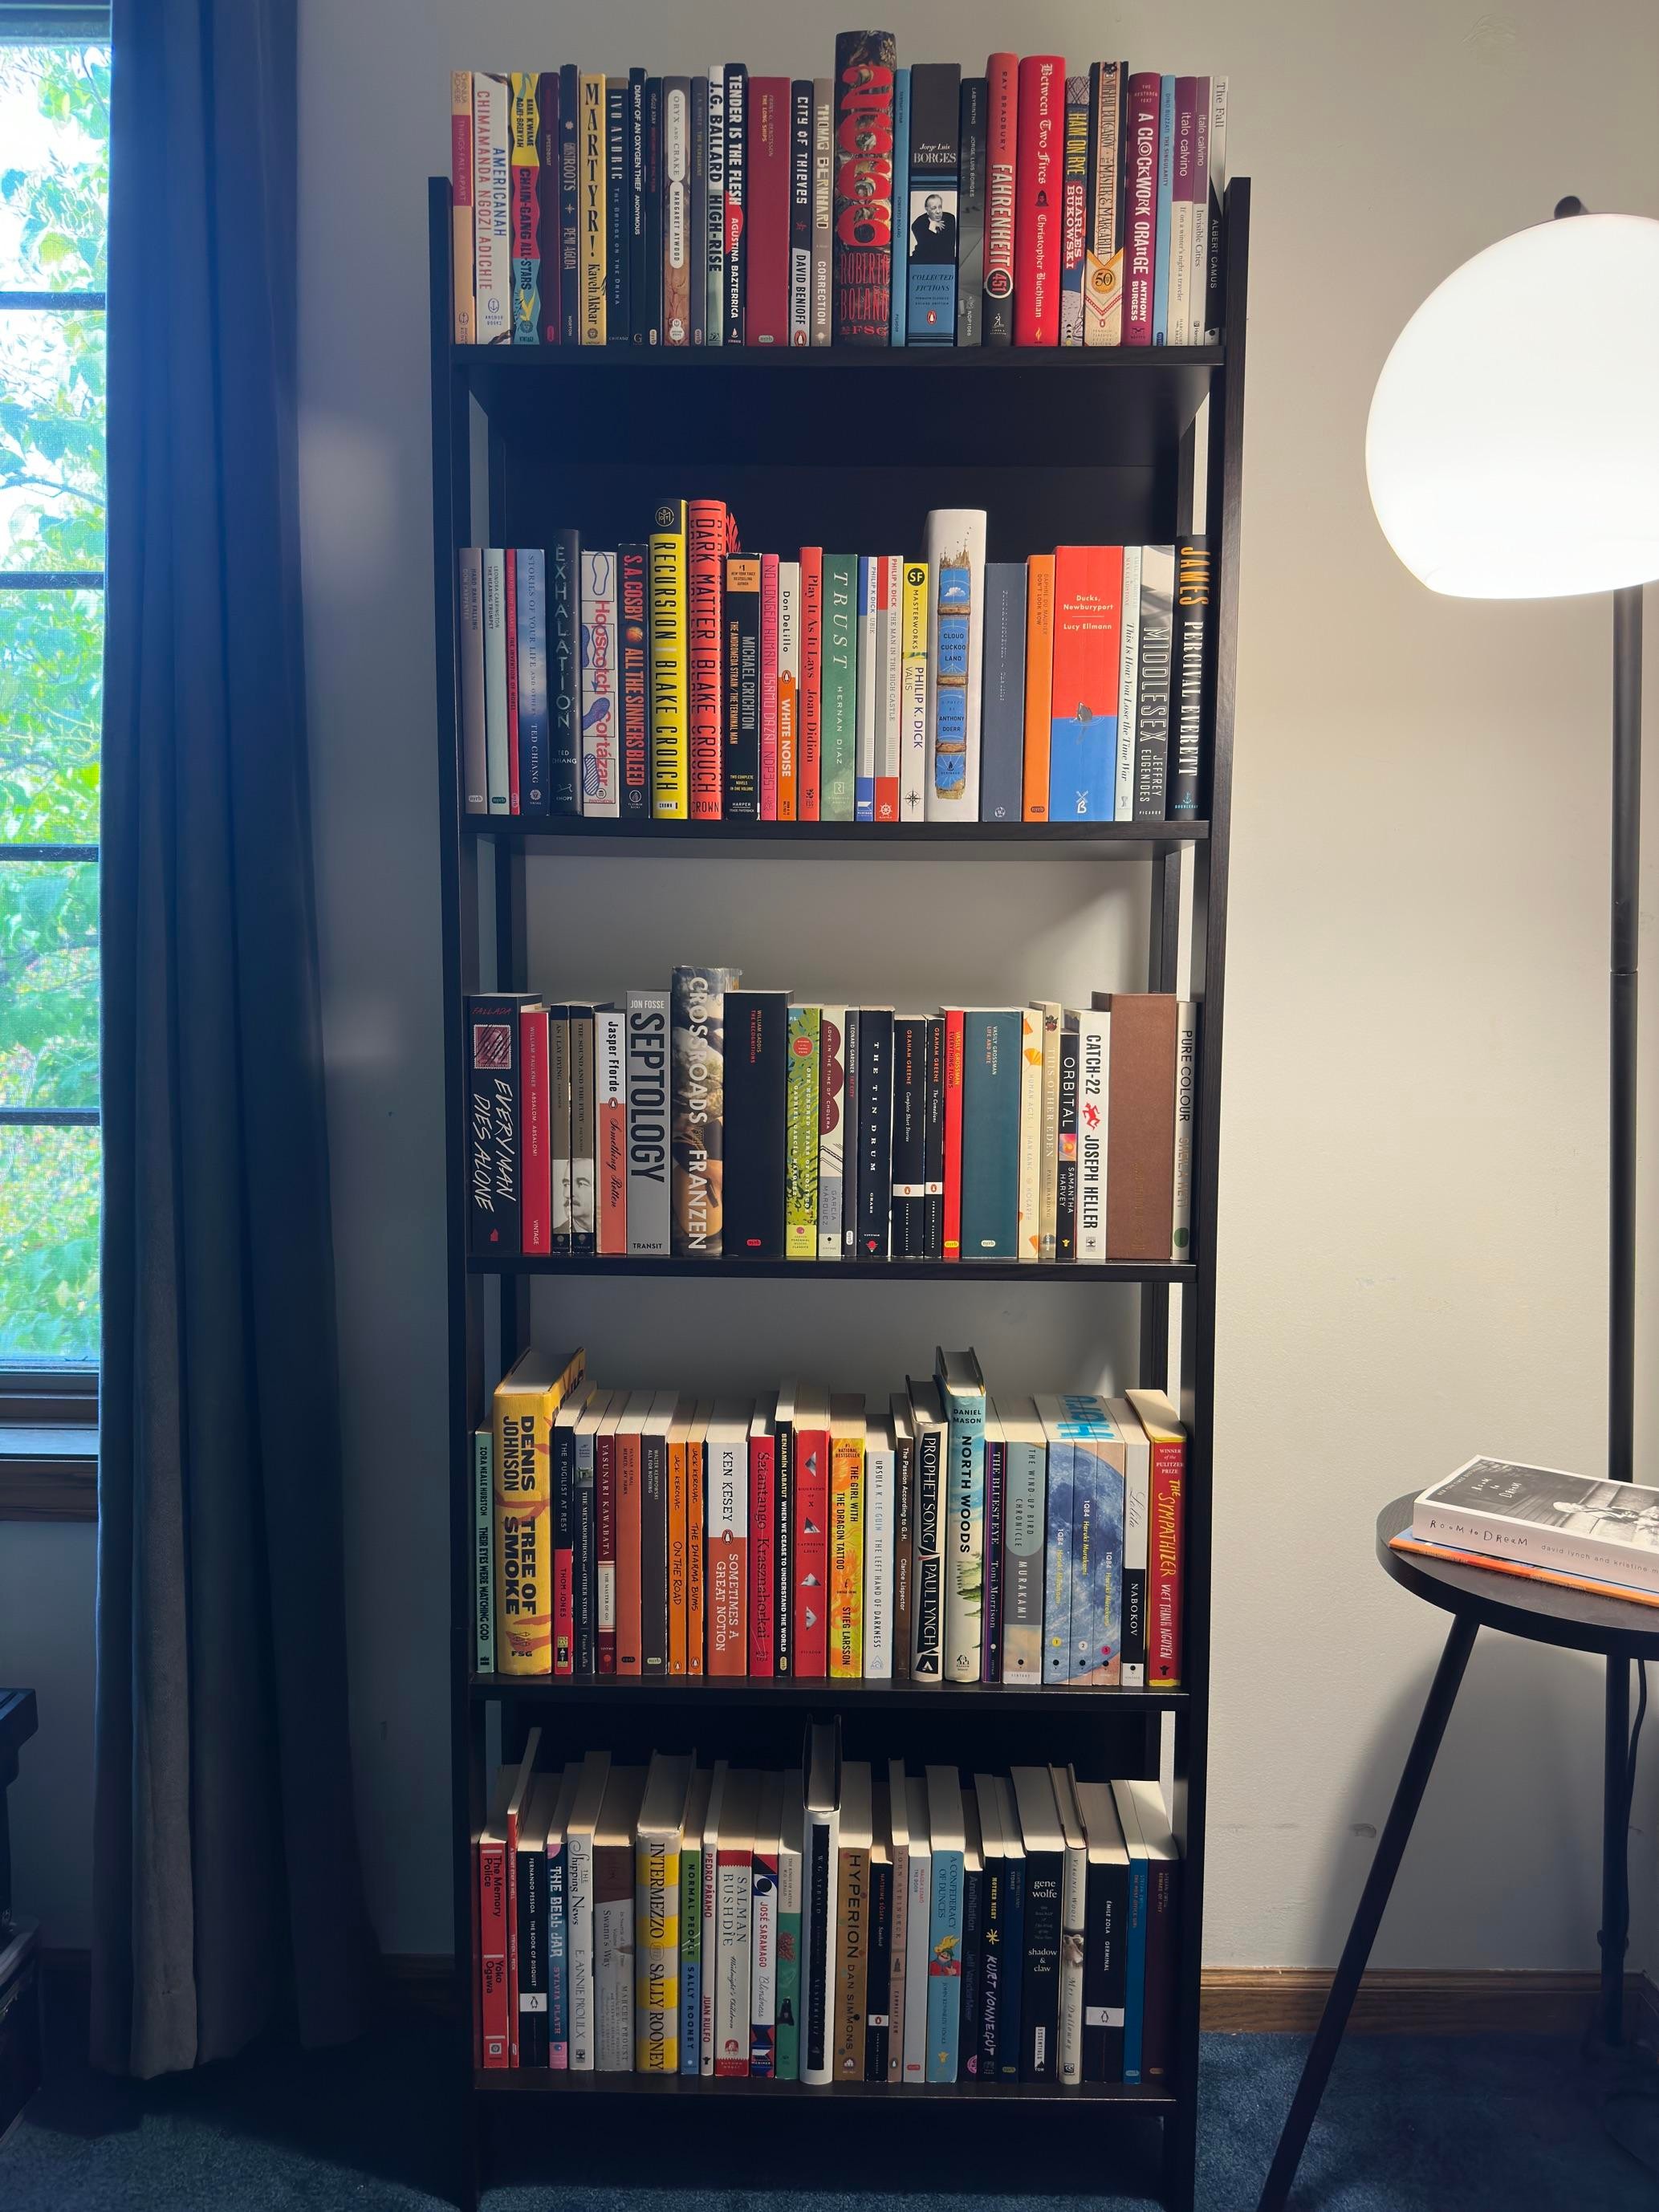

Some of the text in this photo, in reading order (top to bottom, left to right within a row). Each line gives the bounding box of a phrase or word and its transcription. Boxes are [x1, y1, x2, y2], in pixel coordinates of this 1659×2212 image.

[1215, 82, 1226, 128] The Fall
[709, 82, 722, 272] J.G. BALLARD HIGH-RISE
[1179, 112, 1192, 177] italo calvino
[478, 91, 493, 290] CHIMAMANDA NGOZI ADICHIE
[493, 148, 506, 236] AMERICANAH
[585, 83, 601, 324] MARTYR! Kaveh Akbar
[729, 75, 742, 319] TENDER IS THE FLESH AGUSTINA BAZTERRICA
[990, 164, 1013, 292] FAHRENHEIT 451
[1066, 185, 1074, 269] BUKOWSKI
[1074, 185, 1083, 257] CHARLES
[519, 168, 533, 290] CHAIN-GANG ALL-STARS
[1210, 219, 1219, 289] ALBERT CAMUS
[795, 254, 807, 324] DAVID BENIOFF
[1131, 280, 1139, 321] BURGESS
[1139, 280, 1148, 322] ANTHONY
[695, 518, 717, 793] DARK MATTER BLAKE CROUCH
[833, 571, 848, 669] TRUST
[624, 555, 644, 786] S.A. COSBY ALL THE SINNERS BLEED
[654, 542, 678, 791] RECURSION BLAKE CROUCH
[781, 591, 791, 777] Don DeLillo WHITE NOISE
[905, 666, 913, 691] VALIS
[1140, 627, 1169, 742] MIDDLESEX
[1178, 547, 1210, 776] JAMES PERCIVAL EVERETT
[913, 666, 925, 748] PHILIP K. DICK
[1139, 750, 1152, 802] EUGENIDES
[1152, 754, 1163, 796] JEFFREY
[630, 1000, 665, 1008] JON FOSSE
[606, 1021, 620, 1092] Jasper Fforde
[1062, 1057, 1075, 1127] ORBITAL
[630, 1012, 665, 1182] SEPTOLOGY
[688, 977, 708, 1249] CROSSROADS FRANZEN
[1083, 1035, 1101, 1229] CATCH-22 JOSEPH HELLER
[473, 1094, 494, 1213] DIES ALONE
[1059, 1173, 1067, 1207] HARVEY
[1067, 1167, 1075, 1213] SAMANTHA
[503, 1416, 519, 1491] JOHNSON
[521, 1416, 535, 1491] DENIS
[722, 1451, 733, 1522] KEN KESEY
[960, 1436, 972, 1553] NORTH WOODS
[505, 1516, 520, 1615] SMOKE
[522, 1516, 536, 1615] TREE OF
[921, 1437, 937, 1645] PROPHET SONG PAUL LYNCH
[1157, 1479, 1181, 1659] THE SYMPATHIZER VIET THANH NGUYEN
[1541, 1544, 1563, 1555] david
[1568, 1548, 1590, 1561] lynch
[1594, 1555, 1610, 1563] and
[1614, 1558, 1648, 1572] kristine
[715, 1561, 726, 1652] GREAT NOTION
[728, 1553, 738, 1640] SOMETIMES A
[899, 1582, 907, 1611] Lispector
[989, 1560, 999, 1629] Toni Morrison
[1017, 1561, 1027, 1619] MURAKAMI
[1129, 1583, 1138, 1637] NABOKOV
[841, 1607, 852, 1665] STIEG LARSSON
[484, 1857, 492, 1887] Police
[491, 1856, 502, 1917] The Memory
[722, 1873, 735, 1946] RUSHDIE
[736, 1876, 747, 1942] SALMAN
[1031, 1889, 1057, 1898] wolfe
[550, 1866, 562, 1958] THE BELL JAR
[758, 1901, 771, 1967] JOSÉ SARAMAGO
[485, 1961, 494, 1994] Ogawa
[495, 1961, 503, 1983] Yoko
[649, 1843, 665, 2071] INTERMEZZO SALLY ROONEY
[846, 1855, 861, 2050] HYPERION DAN SIMMONS
[1034, 1964, 1051, 1972] claw
[984, 1954, 998, 2055] KURT VONNEGUT
